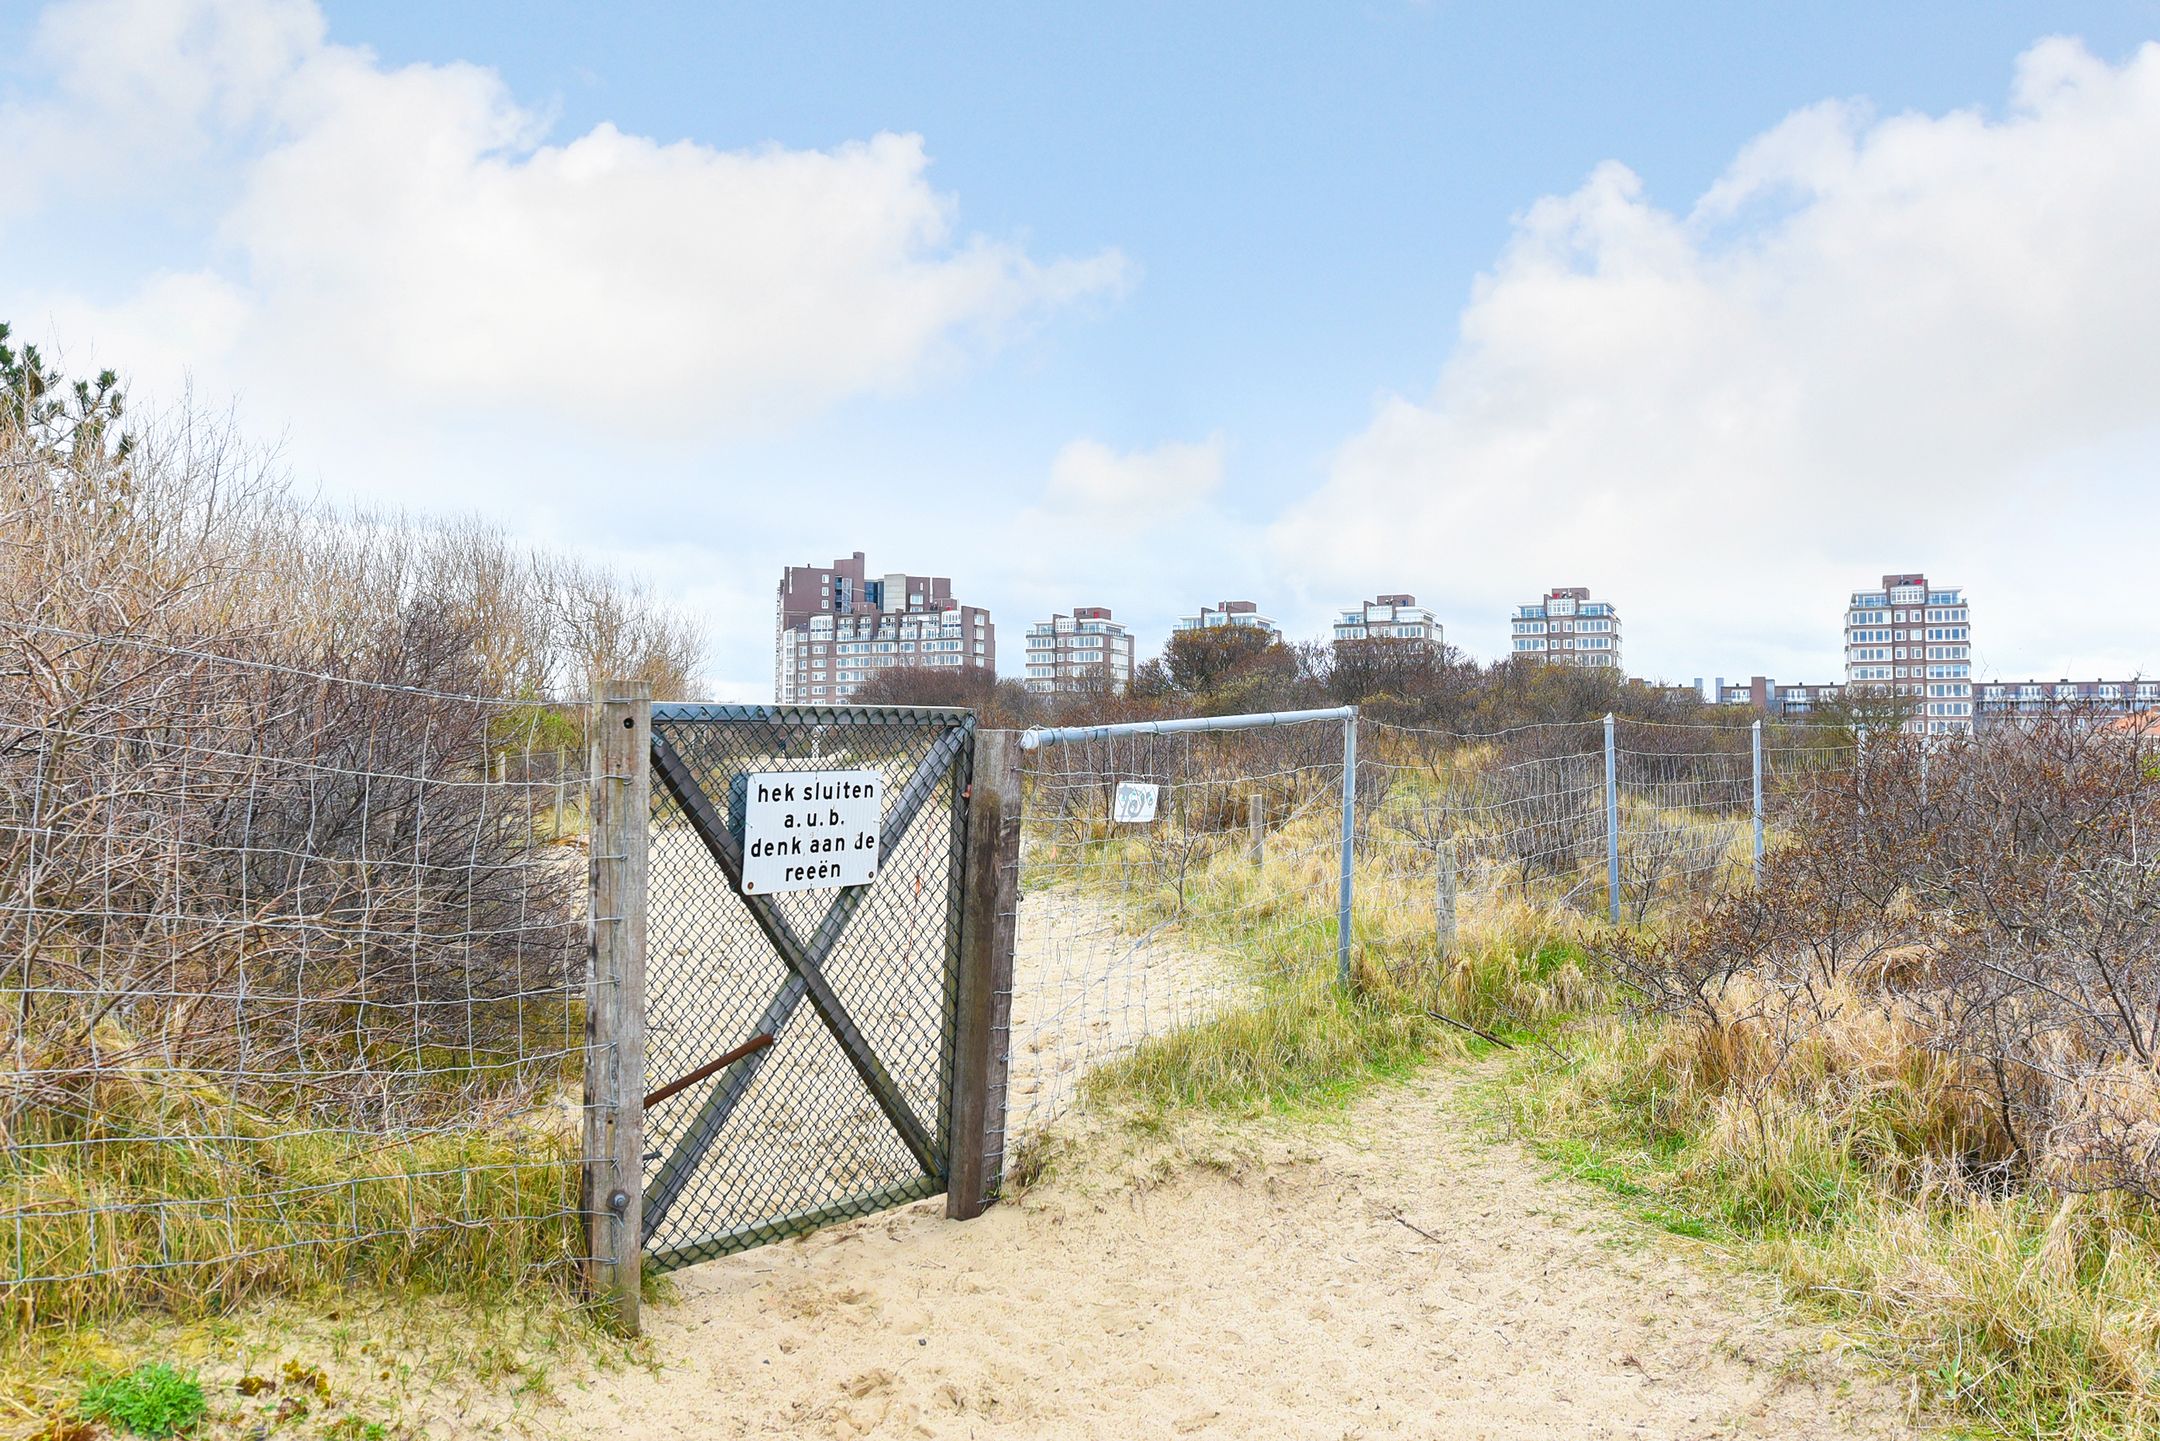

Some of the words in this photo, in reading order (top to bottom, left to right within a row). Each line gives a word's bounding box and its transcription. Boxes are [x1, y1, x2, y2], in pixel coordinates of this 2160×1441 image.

[758, 783, 795, 802] hek
[803, 781, 873, 800] sluiten
[784, 808, 844, 828] a.u.b.
[751, 836, 801, 857] denk
[810, 837, 845, 853] aan
[854, 832, 874, 850] de
[785, 860, 840, 881] reeën
